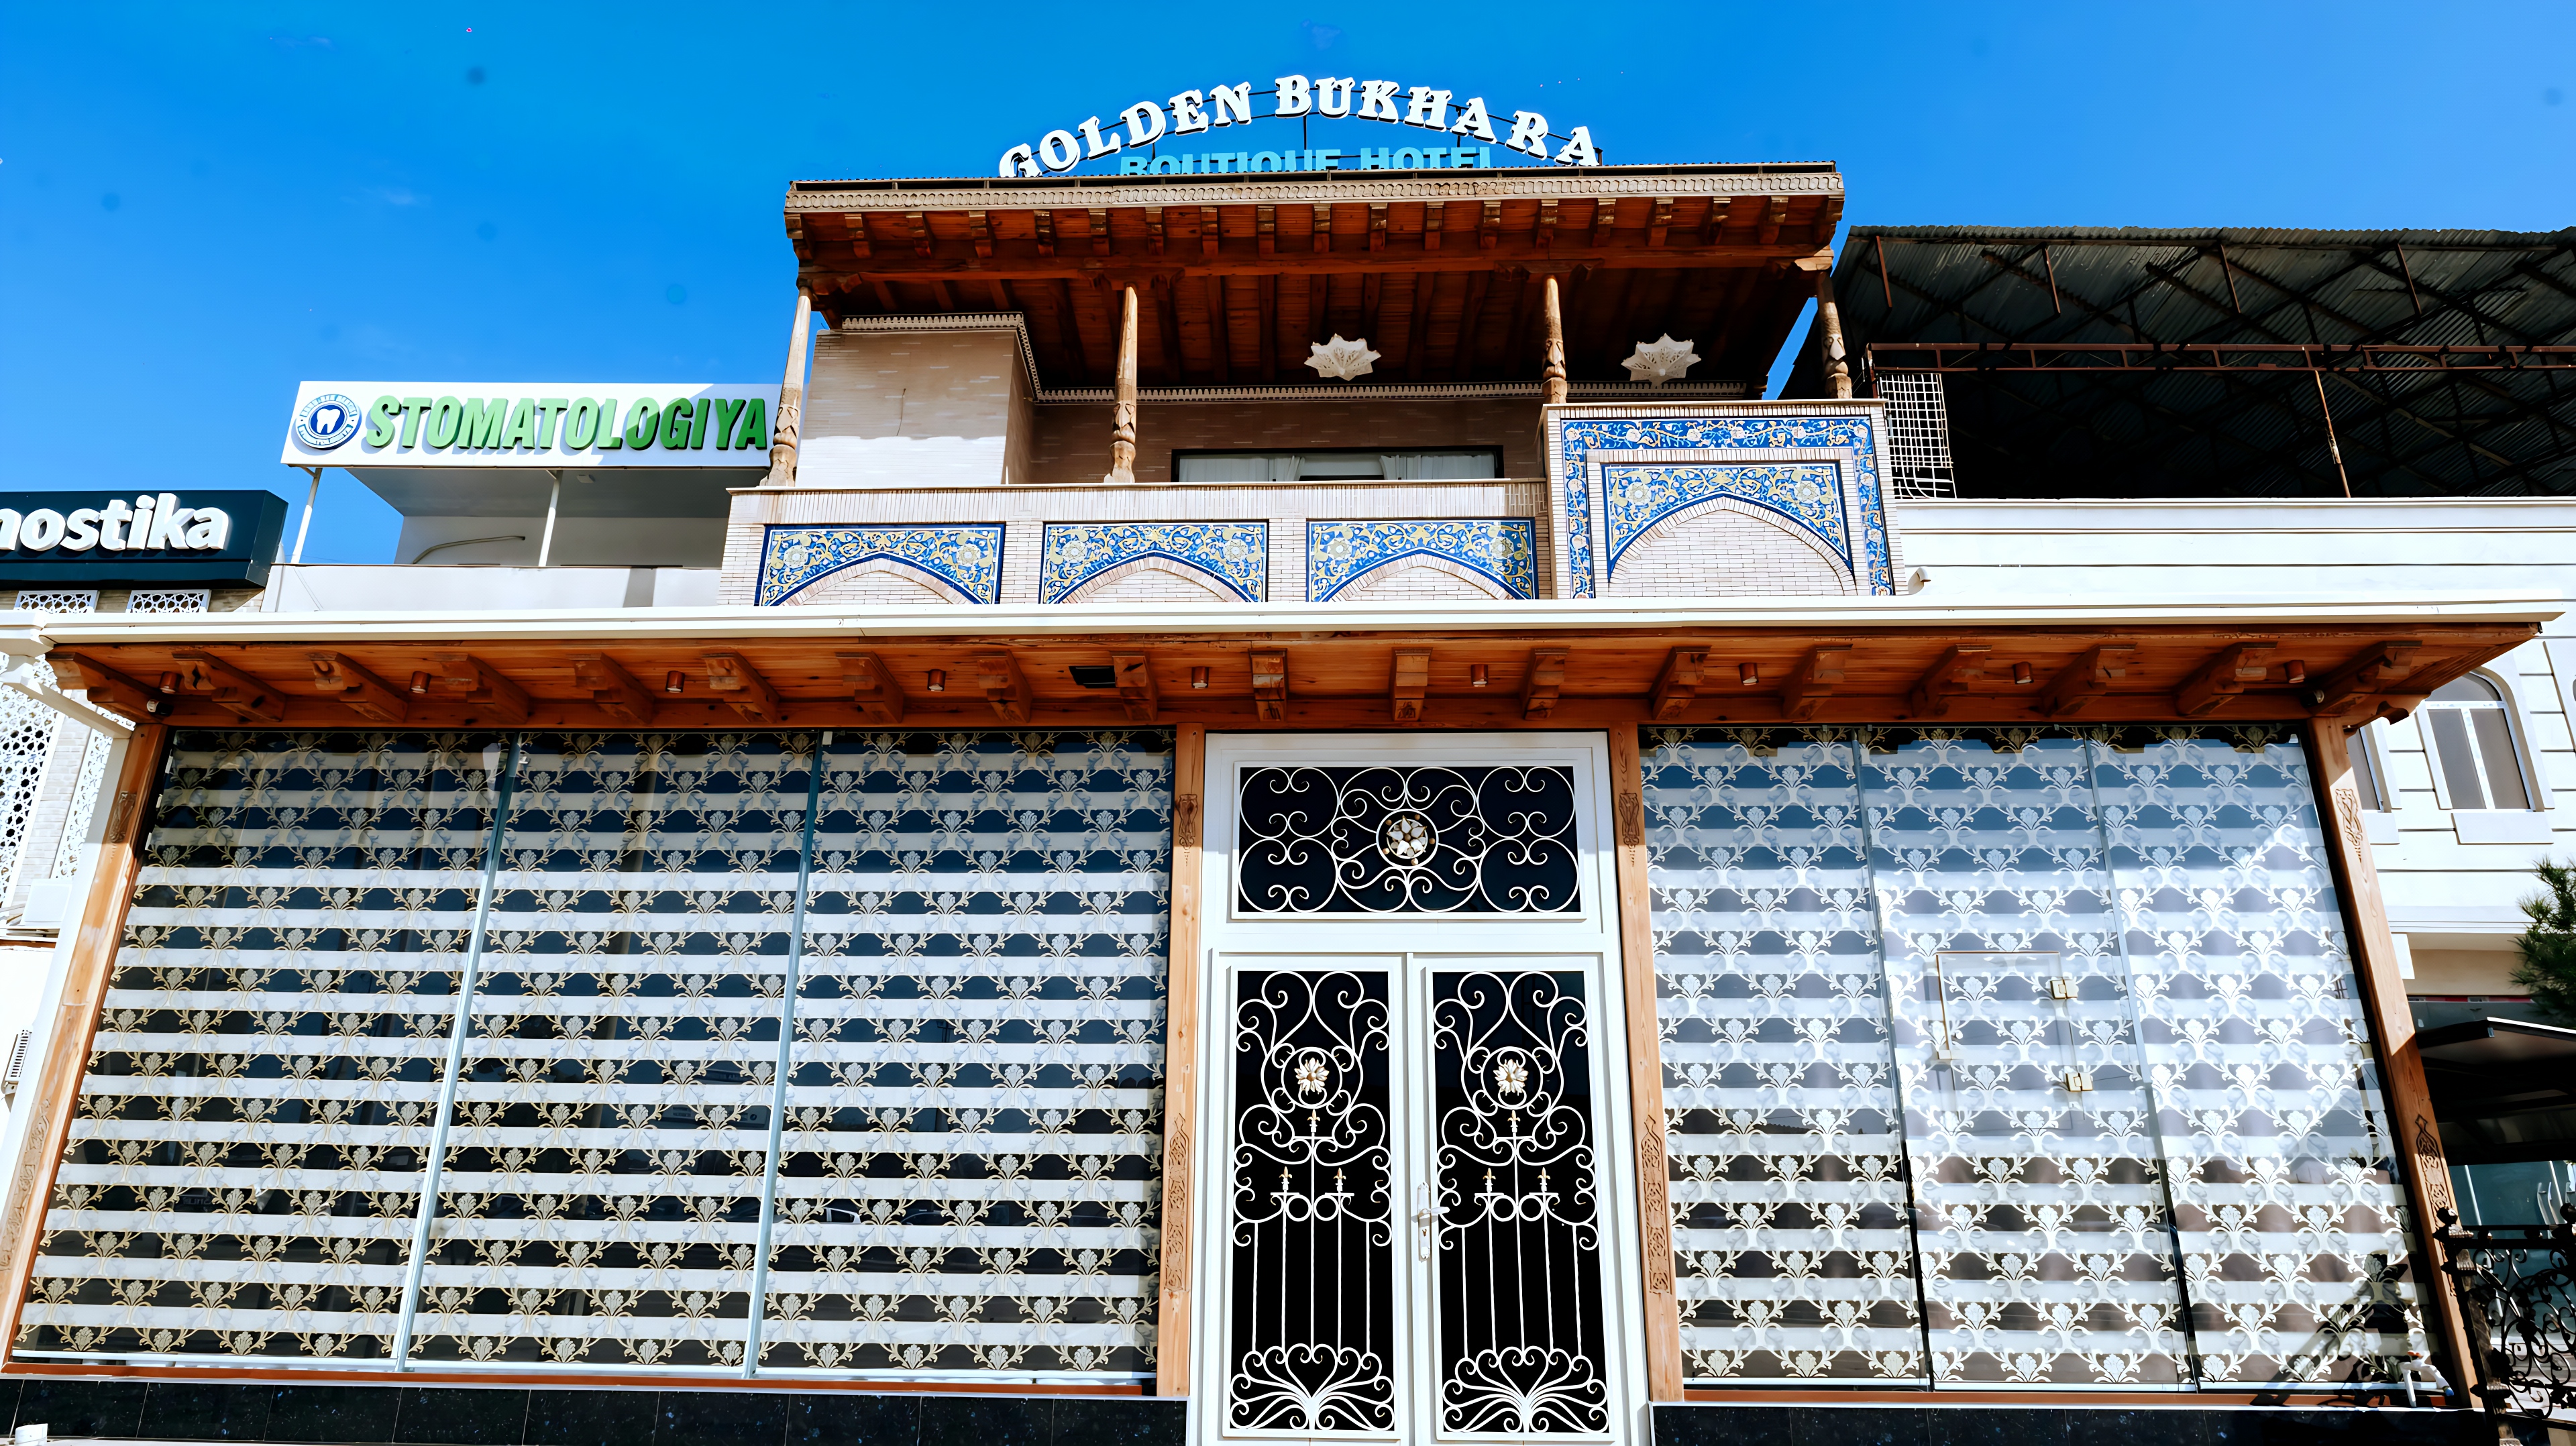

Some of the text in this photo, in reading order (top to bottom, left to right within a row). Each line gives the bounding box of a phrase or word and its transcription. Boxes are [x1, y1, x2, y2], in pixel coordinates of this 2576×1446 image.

[999, 74, 1599, 178] GOLDEN BUKHARA
[366, 395, 767, 451] STOMATOLOGIYA
